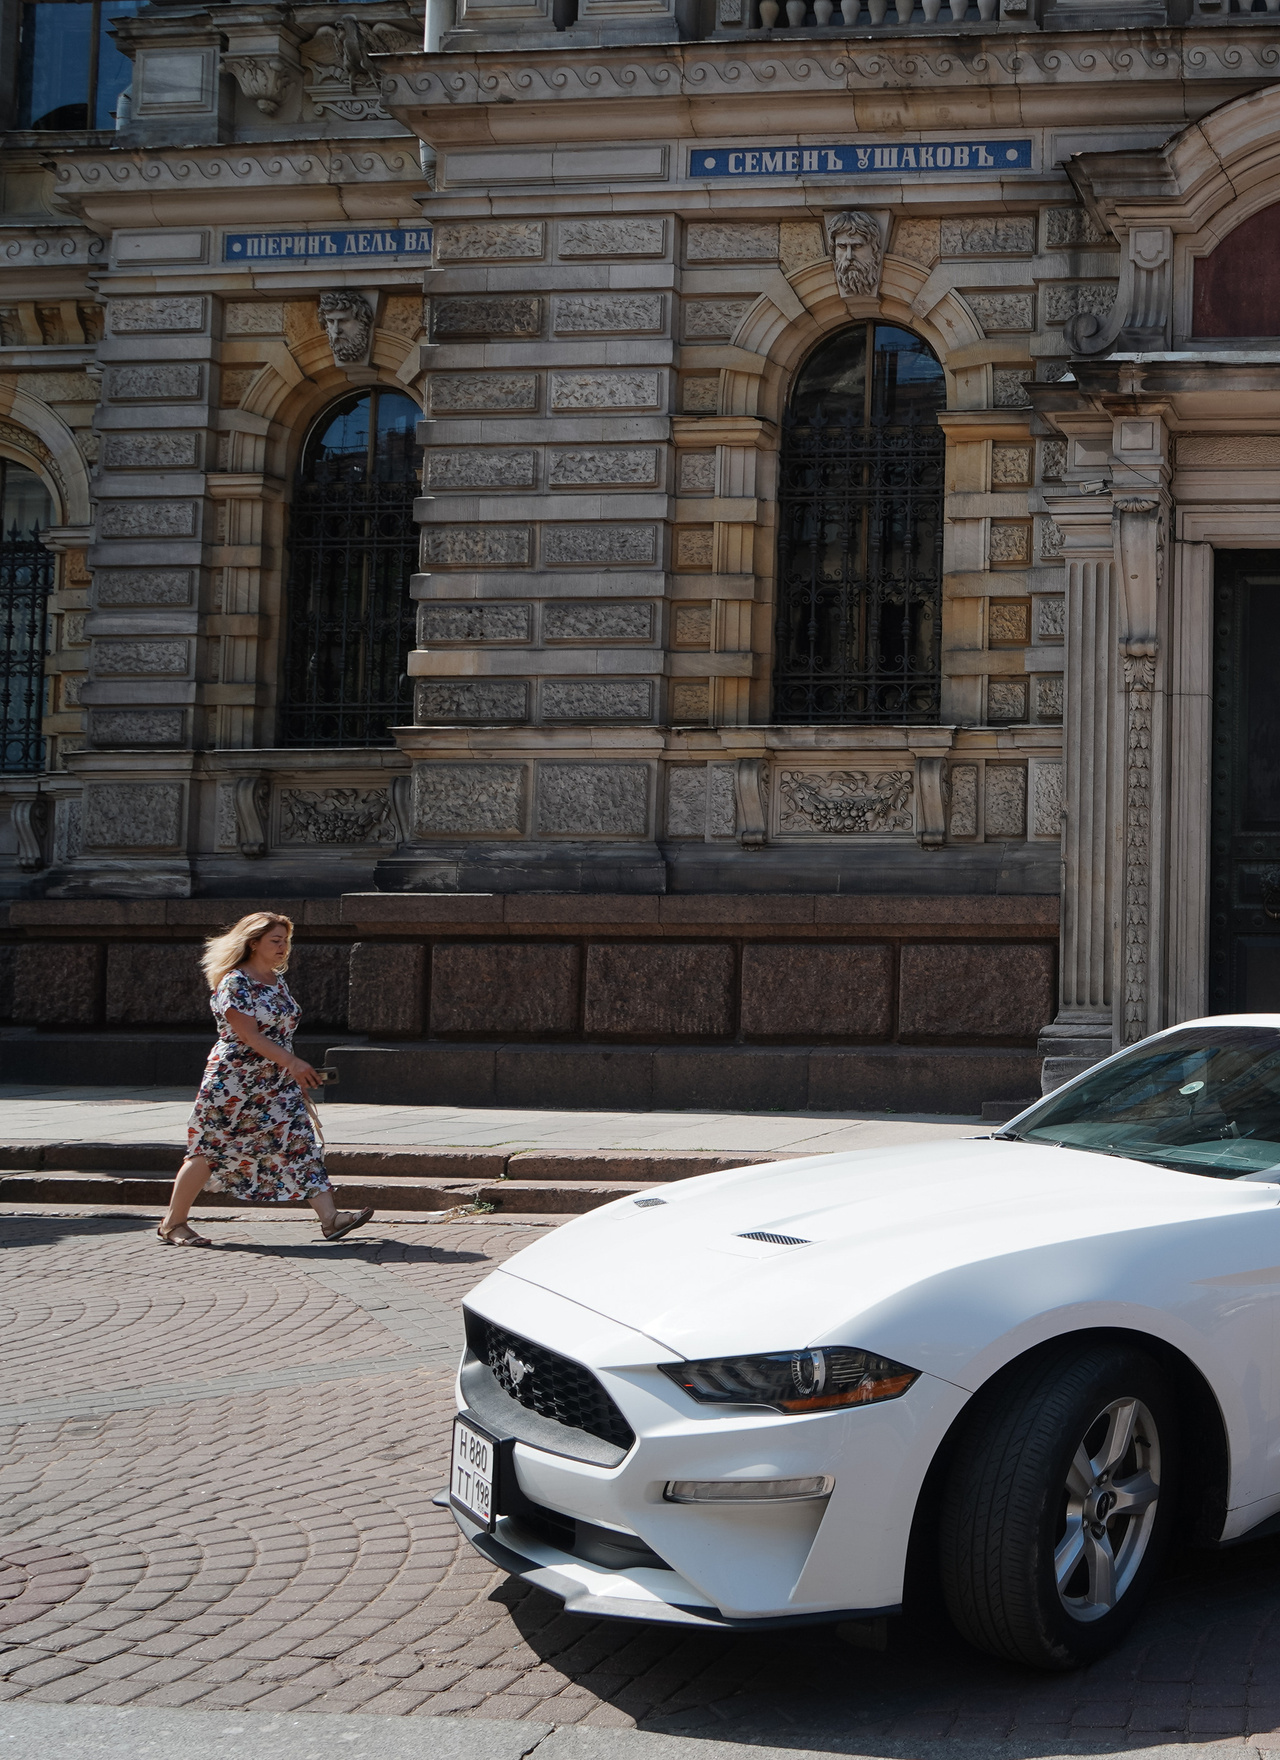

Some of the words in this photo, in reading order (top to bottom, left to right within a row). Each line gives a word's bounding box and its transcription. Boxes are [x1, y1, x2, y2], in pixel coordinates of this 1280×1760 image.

[727, 150, 843, 174] СЕМЕНЪ
[855, 145, 995, 170] УШАКОВЪ
[343, 232, 397, 254] ДЕЛЬ
[475, 1479, 490, 1508] 198
